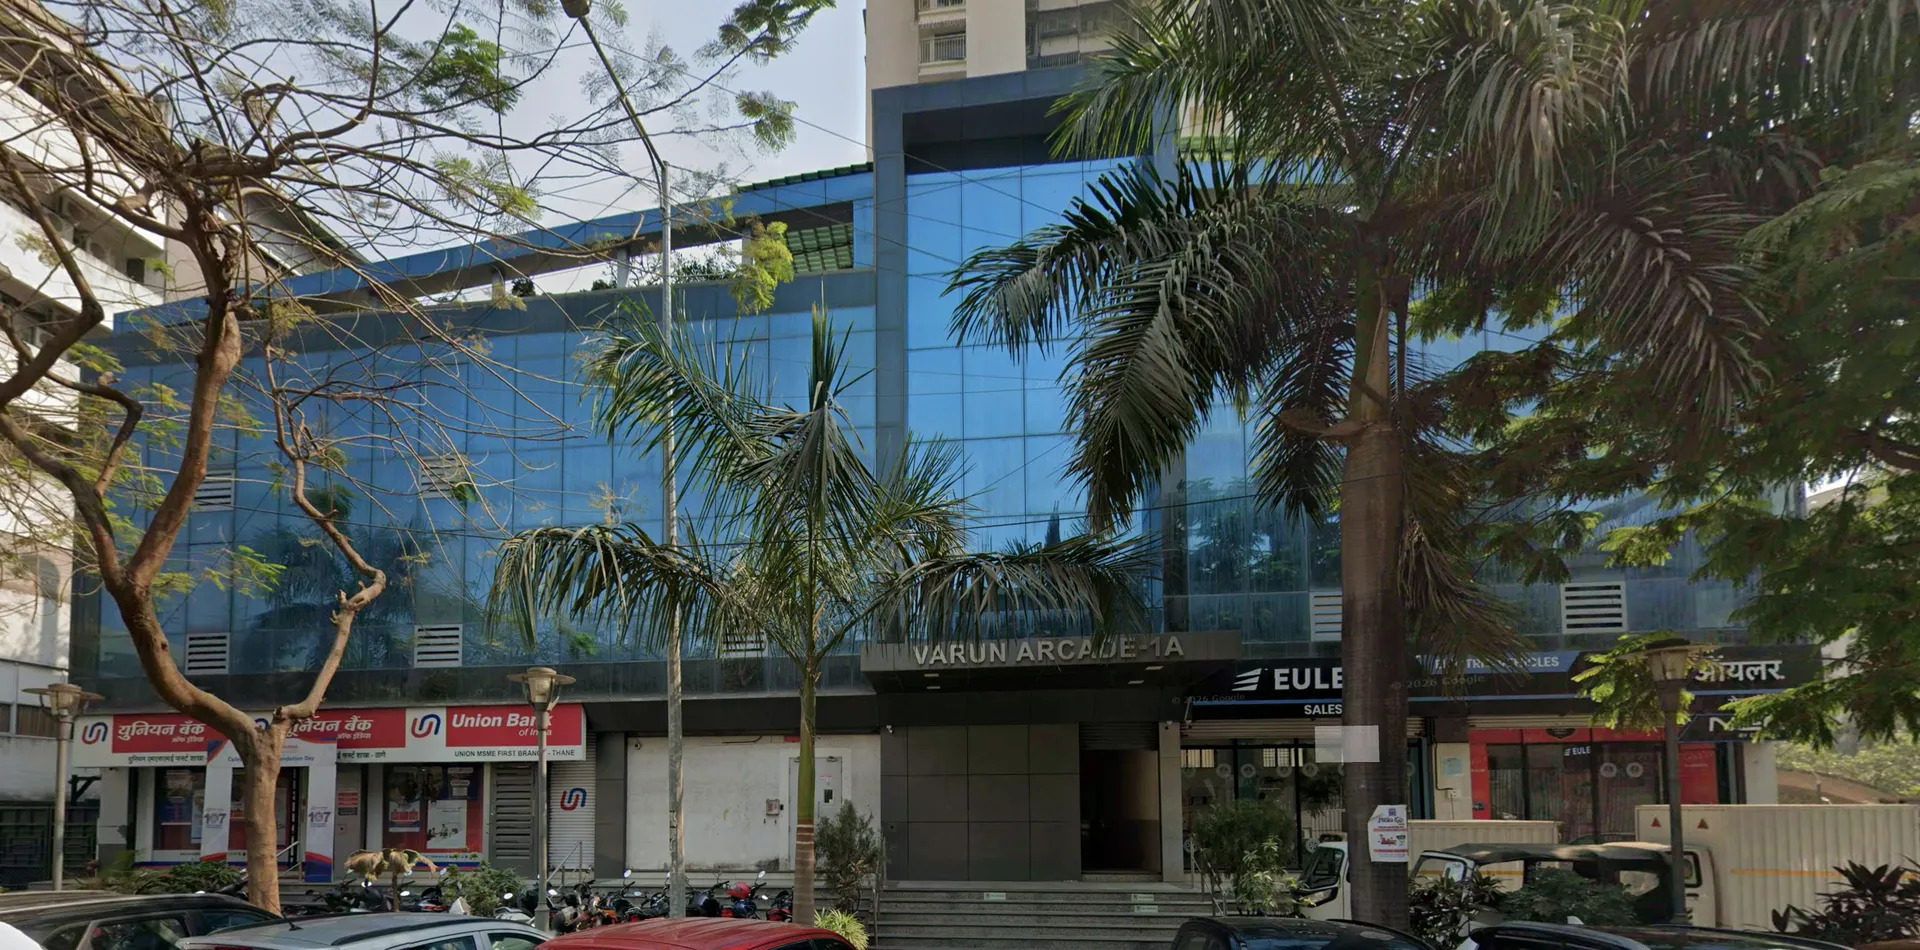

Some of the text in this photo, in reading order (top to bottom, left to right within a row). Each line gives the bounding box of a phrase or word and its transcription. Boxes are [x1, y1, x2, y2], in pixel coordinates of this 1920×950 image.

[913, 642, 1006, 665] VARUN
[1274, 667, 1343, 690] EULE
[1304, 704, 1343, 714] SALES
[451, 713, 502, 728] Union
[518, 728, 552, 736] of Ina
[1572, 746, 1591, 755] EULE
